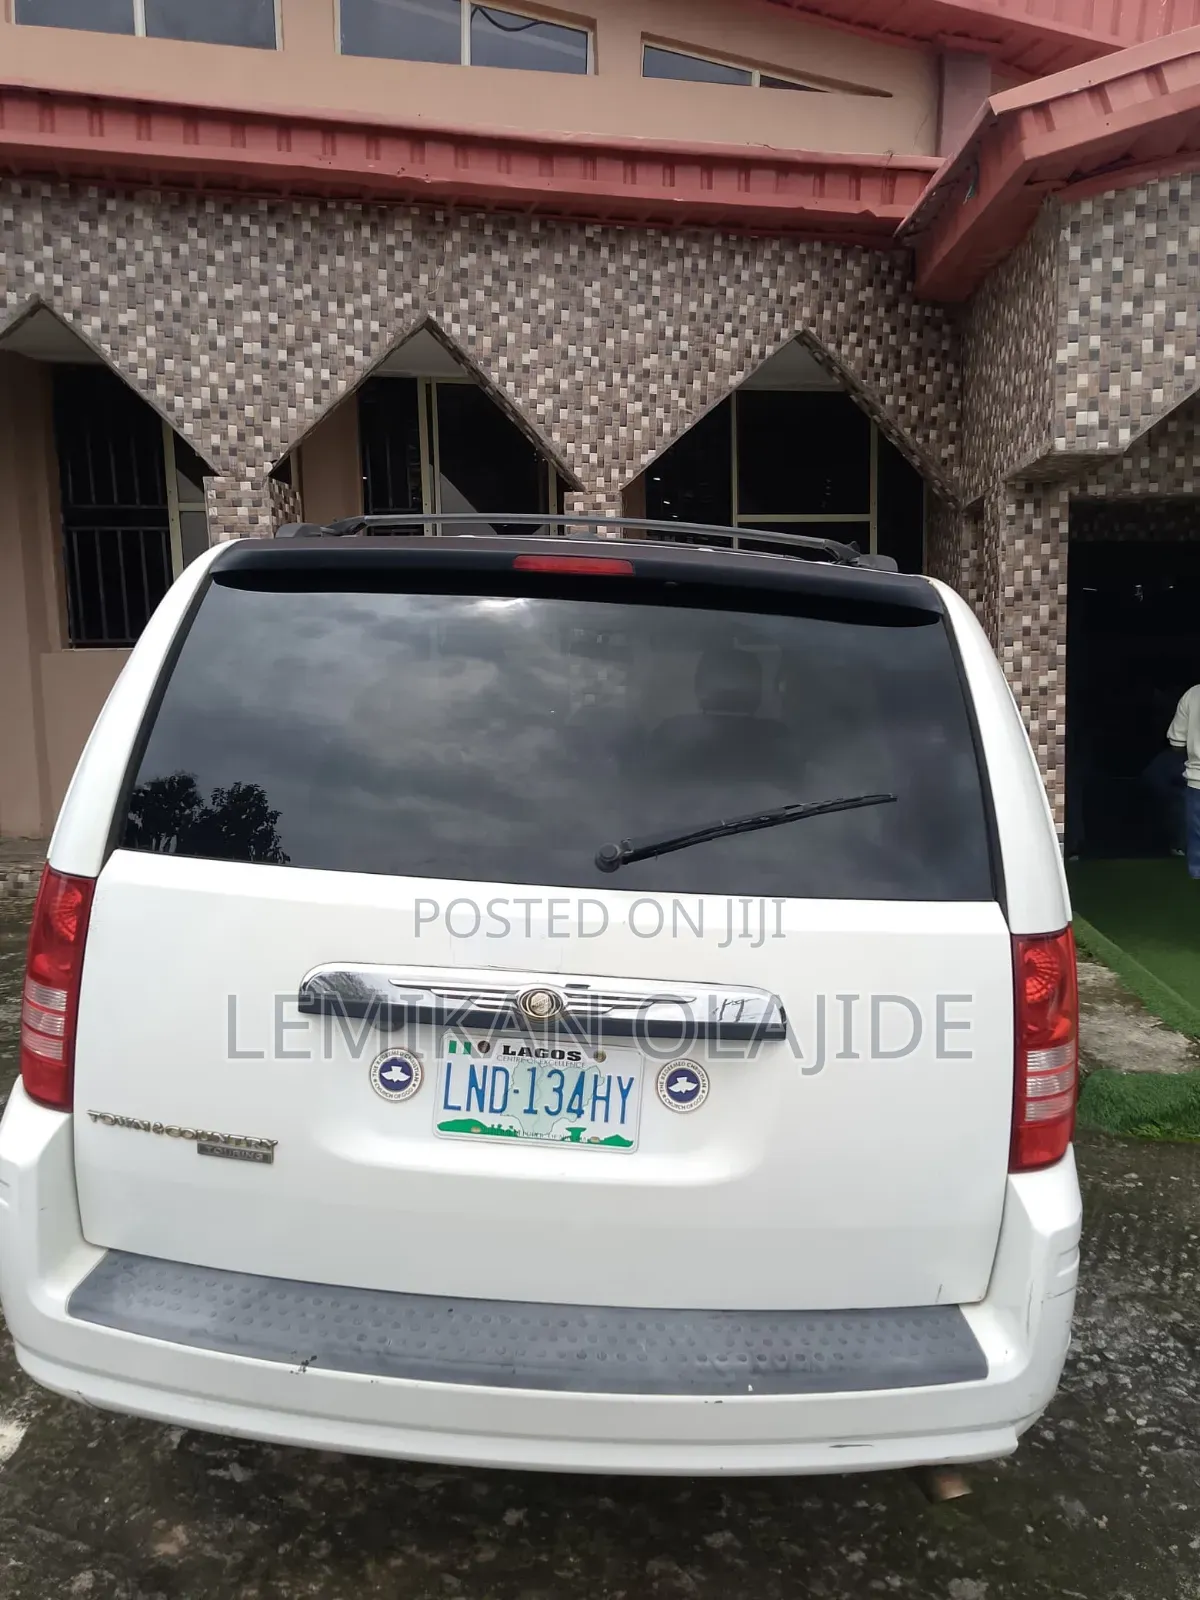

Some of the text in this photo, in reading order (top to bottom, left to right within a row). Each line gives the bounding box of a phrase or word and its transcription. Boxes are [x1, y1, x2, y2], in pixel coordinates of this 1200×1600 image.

[502, 1045, 582, 1061] LAGOS
[443, 1062, 635, 1124] LND-134HY
[205, 1146, 264, 1161] TOURING
